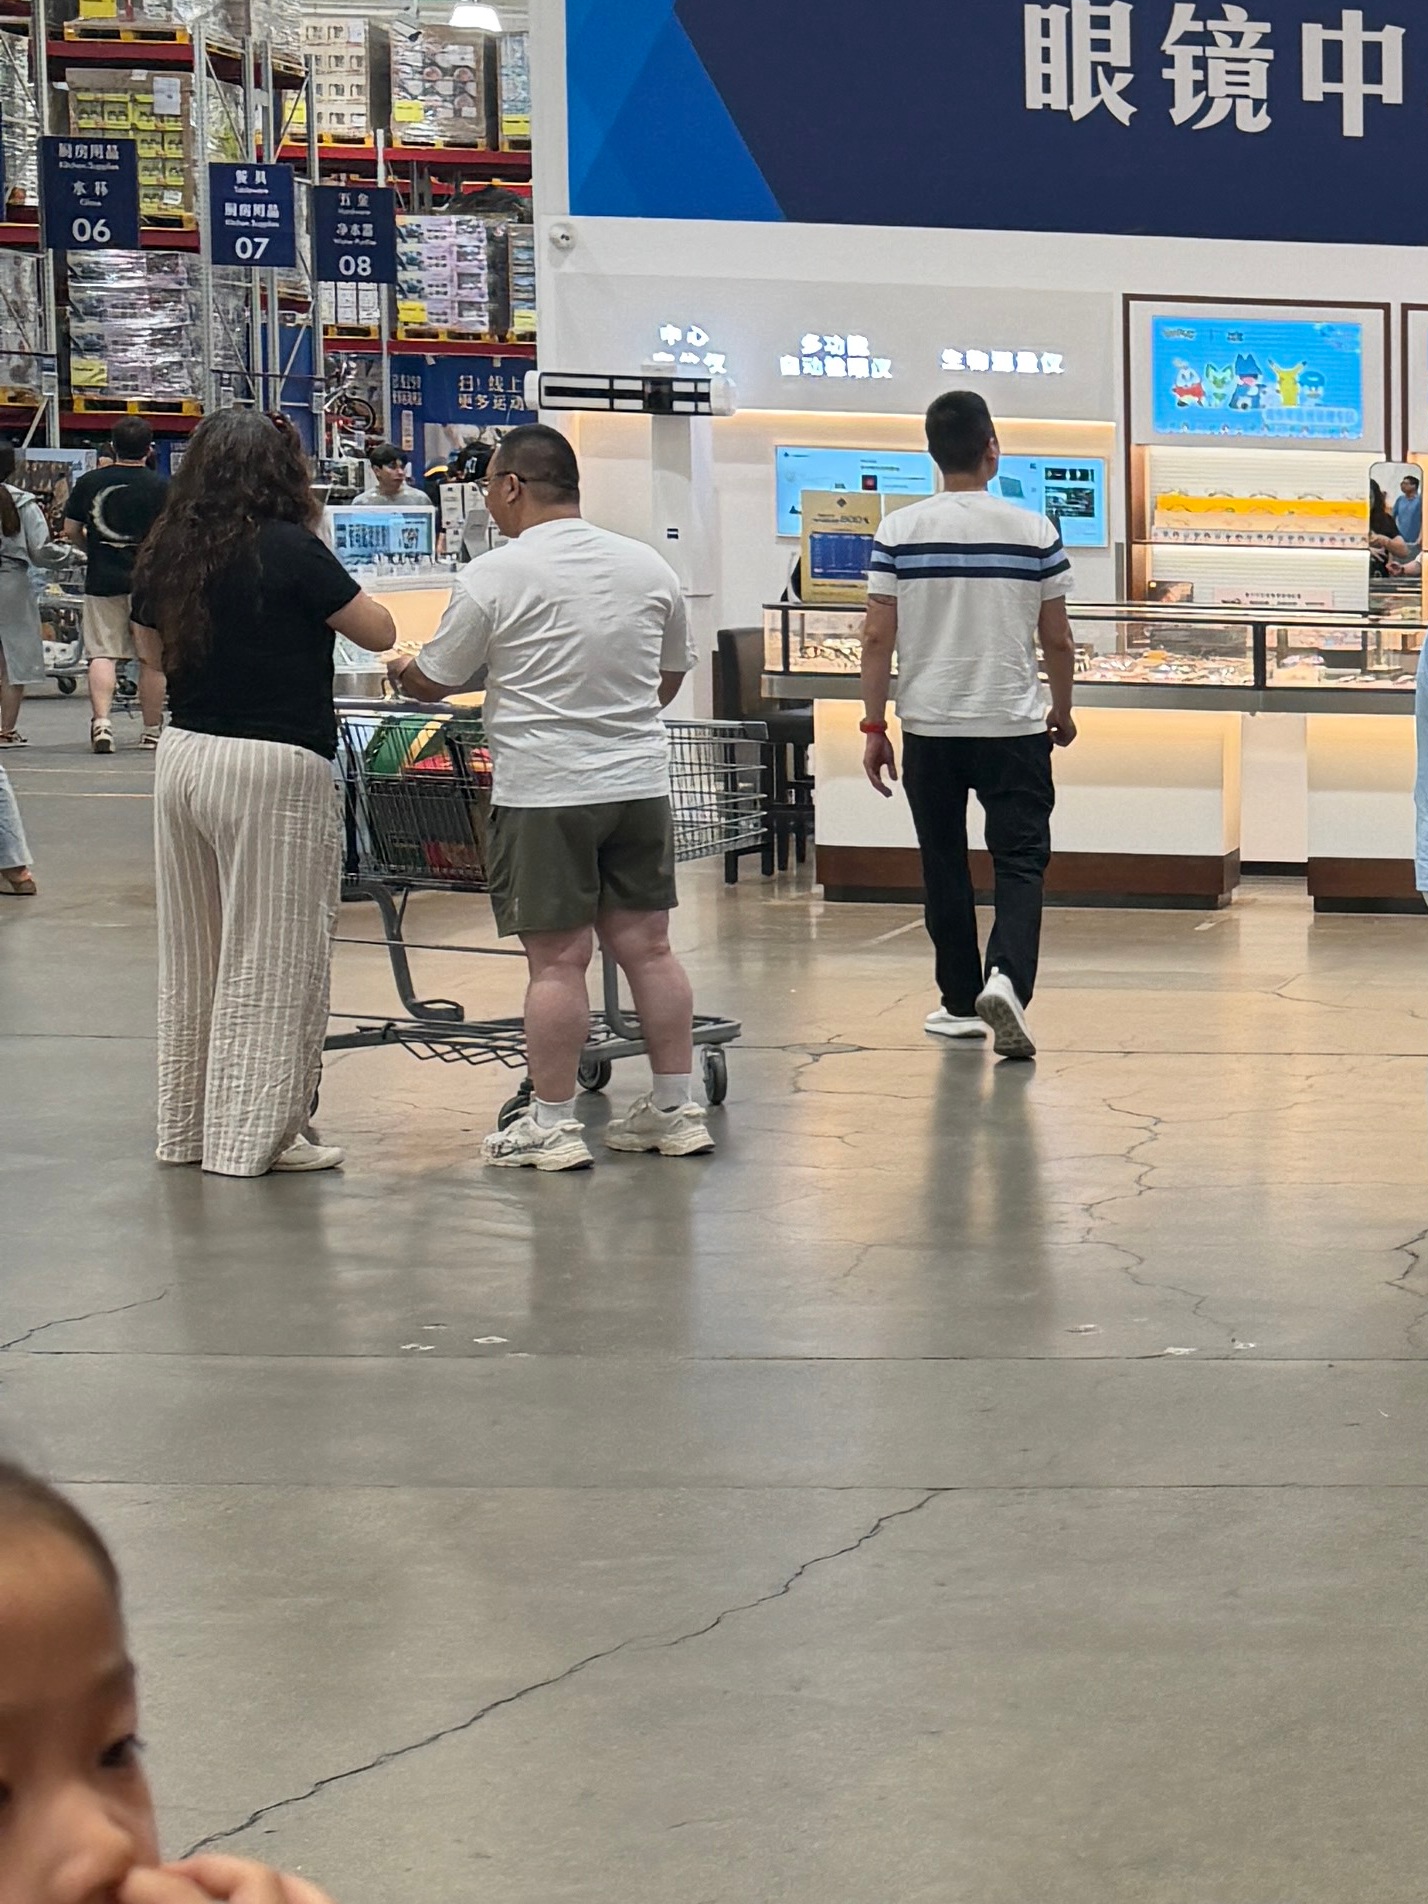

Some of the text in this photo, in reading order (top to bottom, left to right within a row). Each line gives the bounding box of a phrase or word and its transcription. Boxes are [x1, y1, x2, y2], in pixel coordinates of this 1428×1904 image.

[72, 217, 111, 243] 06
[235, 236, 269, 260] 07
[338, 255, 372, 276] 08
